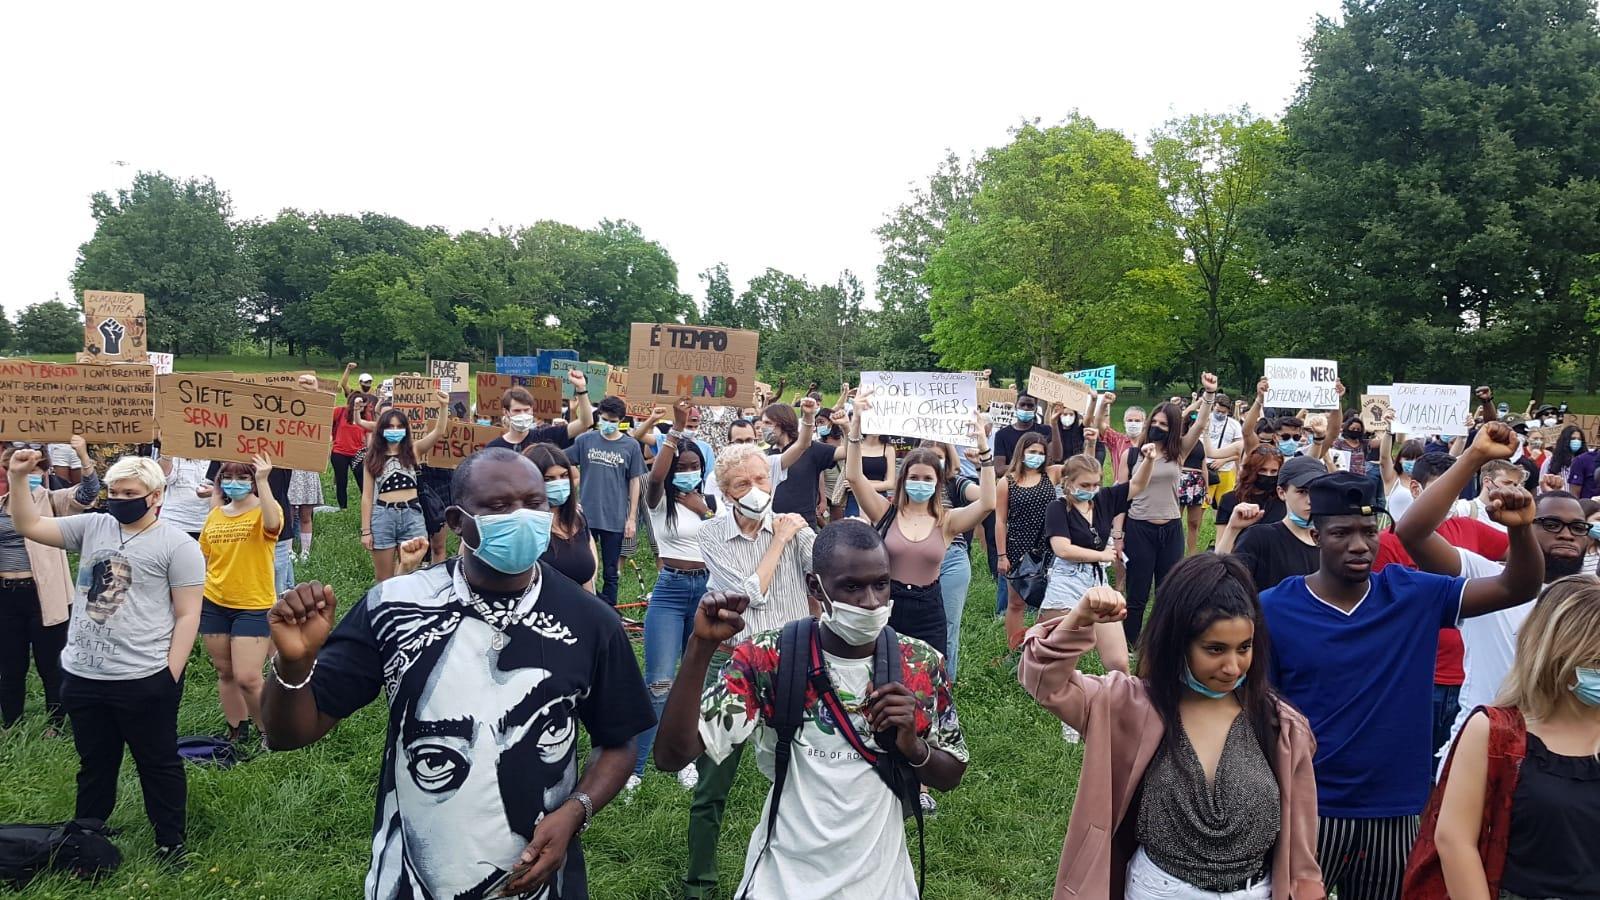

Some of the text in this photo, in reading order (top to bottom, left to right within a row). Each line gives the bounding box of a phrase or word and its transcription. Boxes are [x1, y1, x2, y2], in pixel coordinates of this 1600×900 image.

[667, 328, 728, 352] TEMPO
[433, 360, 458, 370] BLACK
[637, 349, 745, 374] DI CAMBIARE
[112, 369, 151, 378] BREATHE
[265, 375, 296, 383] IGNORA
[433, 368, 456, 377] LIVES
[478, 374, 497, 387] NO
[1310, 366, 1336, 382] NERO
[394, 378, 432, 390] PROTECT
[651, 373, 738, 399] IL MONDO
[888, 382, 912, 397] ONE
[914, 382, 926, 396] IS
[929, 382, 959, 397] FREE
[178, 379, 306, 417] SIETE SOLO
[394, 393, 432, 404] INNOCENT
[1267, 386, 1338, 406] DIFFERENZA ZERO
[871, 398, 969, 416] WHEN OTHERS
[1, 420, 142, 435] I CAN'T BREATHE
[183, 407, 321, 440] SERVI DEI SERVI
[442, 425, 475, 442] URIDI
[194, 431, 284, 457] DEI SERVI
[80, 620, 114, 636] CAN'T
[75, 635, 120, 655] REATHE
[808, 749, 826, 758] BED
[830, 752, 842, 760] OF
